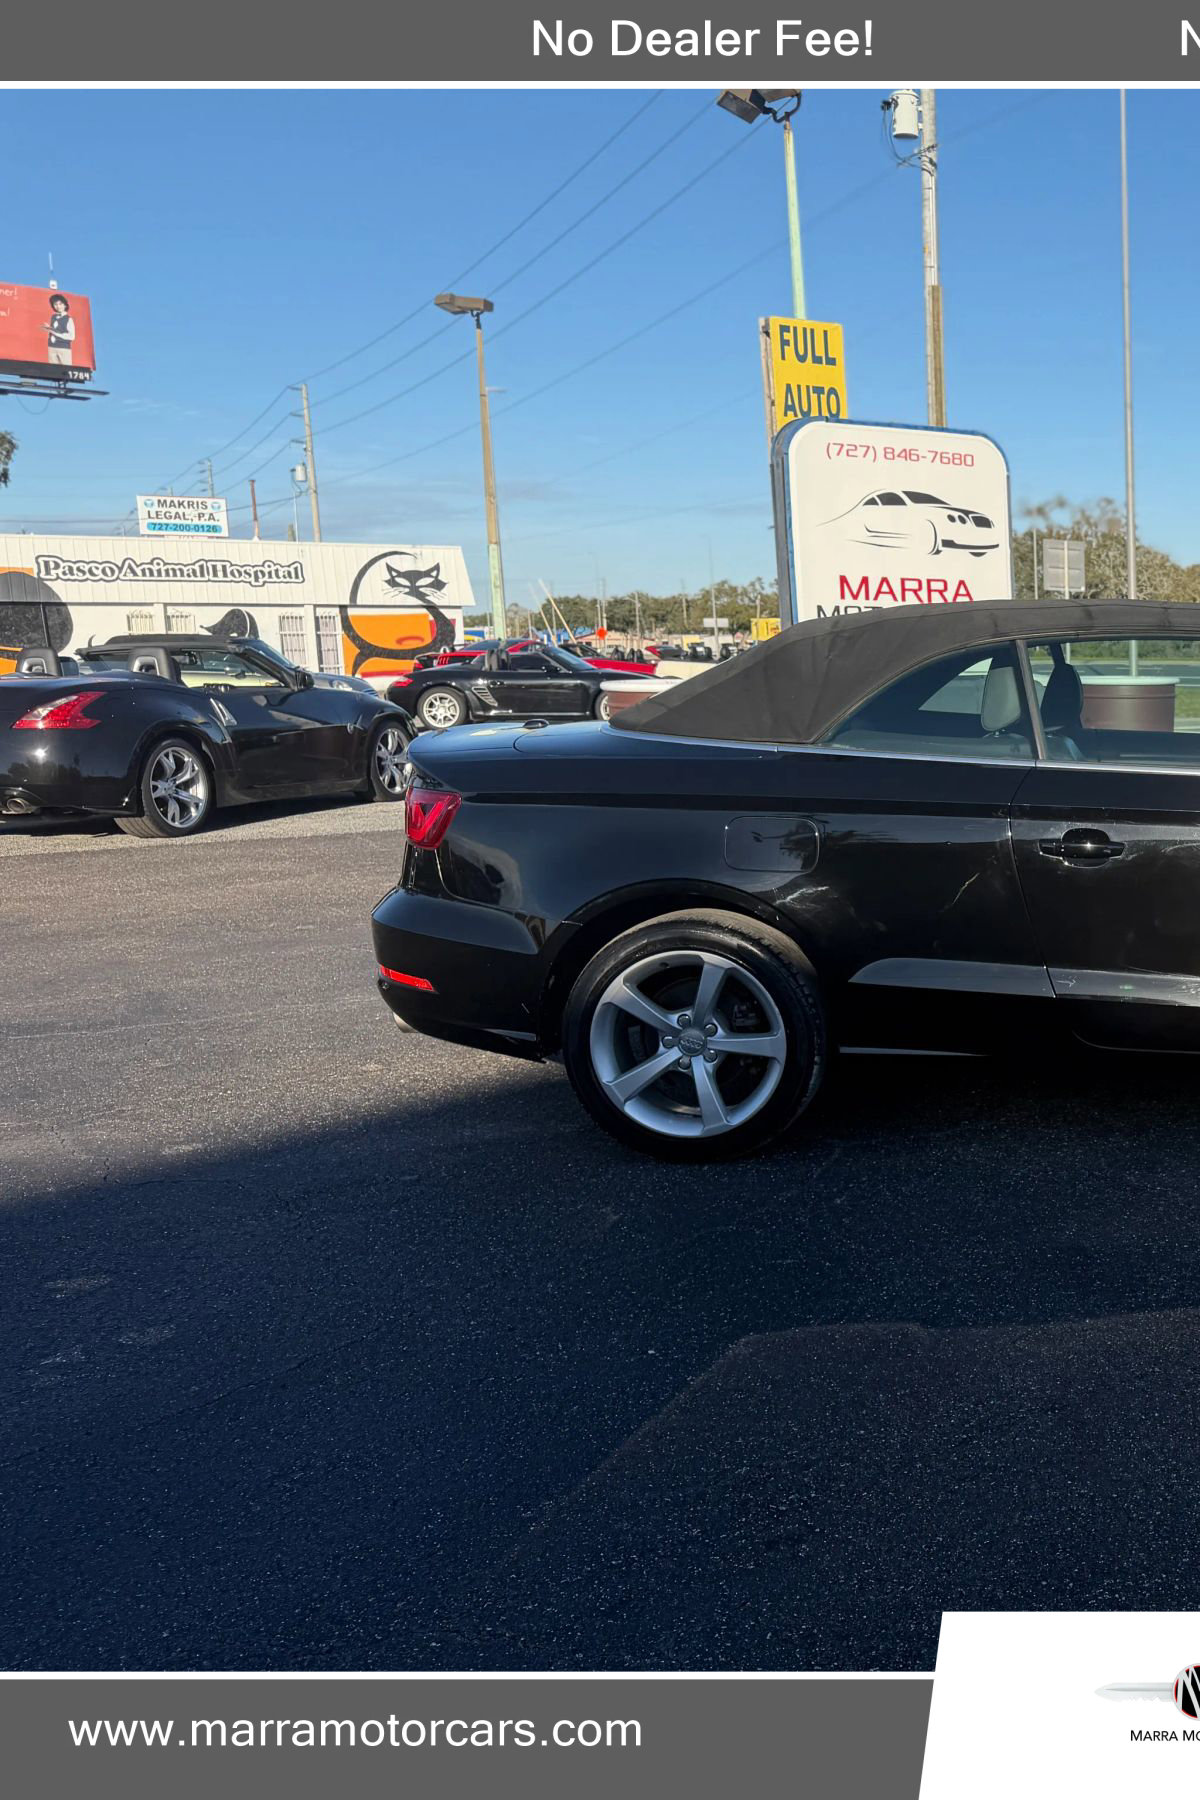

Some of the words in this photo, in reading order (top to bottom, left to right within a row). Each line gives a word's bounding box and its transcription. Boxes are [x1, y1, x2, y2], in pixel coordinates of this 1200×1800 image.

[778, 324, 837, 367] FULL
[783, 383, 841, 418] AUTO
[825, 442, 878, 463] (727)
[883, 446, 975, 468] 846-7680
[147, 510, 194, 522] LEGAL,
[197, 512, 221, 522] P.A.
[156, 499, 209, 510] MAKRIS
[150, 523, 219, 534] 727-200-0126
[39, 557, 118, 580] Pasco
[120, 558, 207, 581] Animal
[208, 560, 303, 585] Hospital
[838, 574, 975, 605] MARRA
